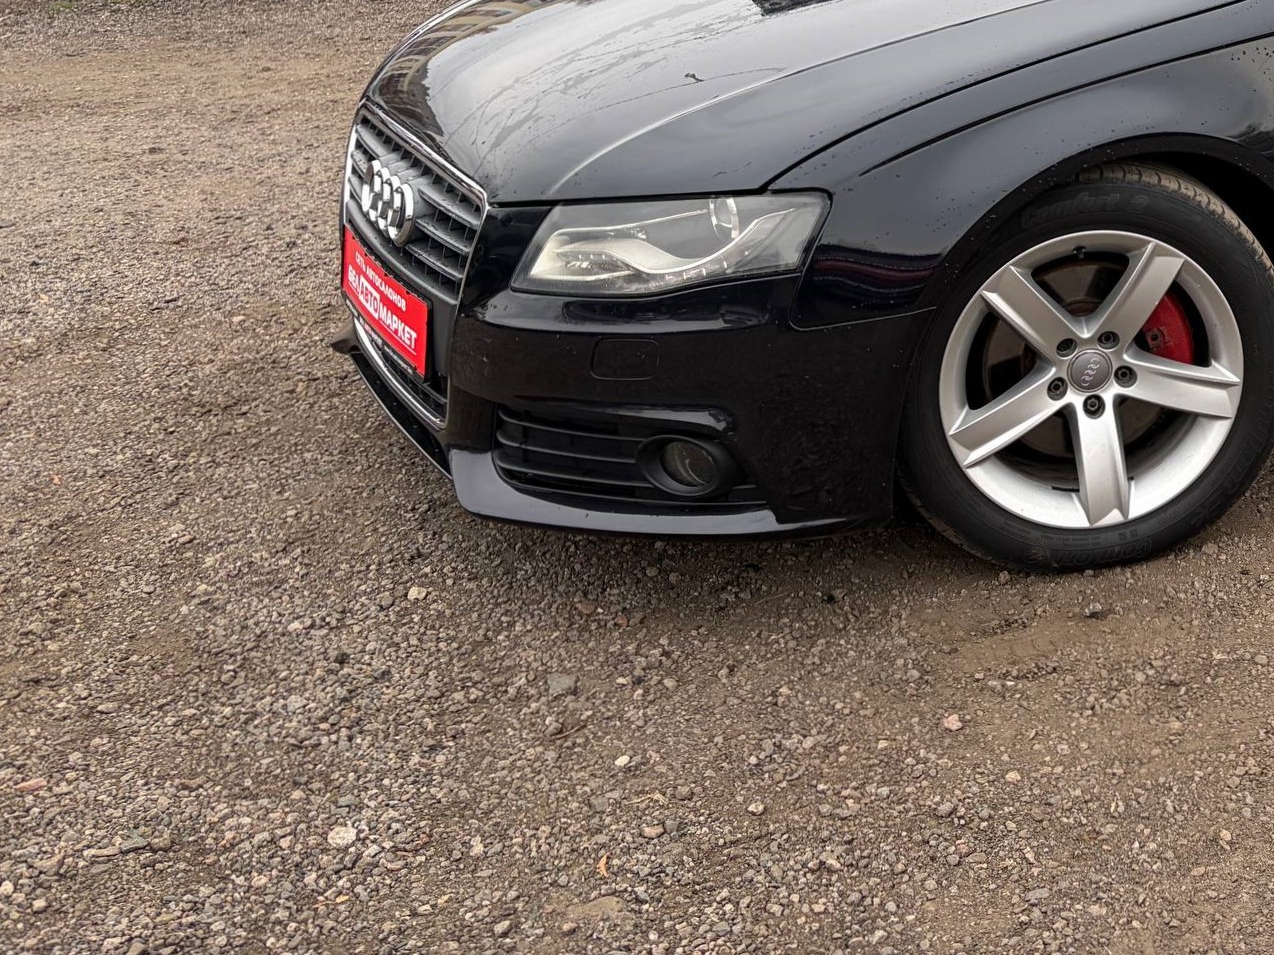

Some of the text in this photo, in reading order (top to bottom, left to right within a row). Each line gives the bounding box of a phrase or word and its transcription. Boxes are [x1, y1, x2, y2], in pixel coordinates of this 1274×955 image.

[348, 263, 418, 350] БЕЛ АВТО МАРКЕТ
[354, 251, 407, 312] СЕТЬ АВТОСАЛОНОВ
